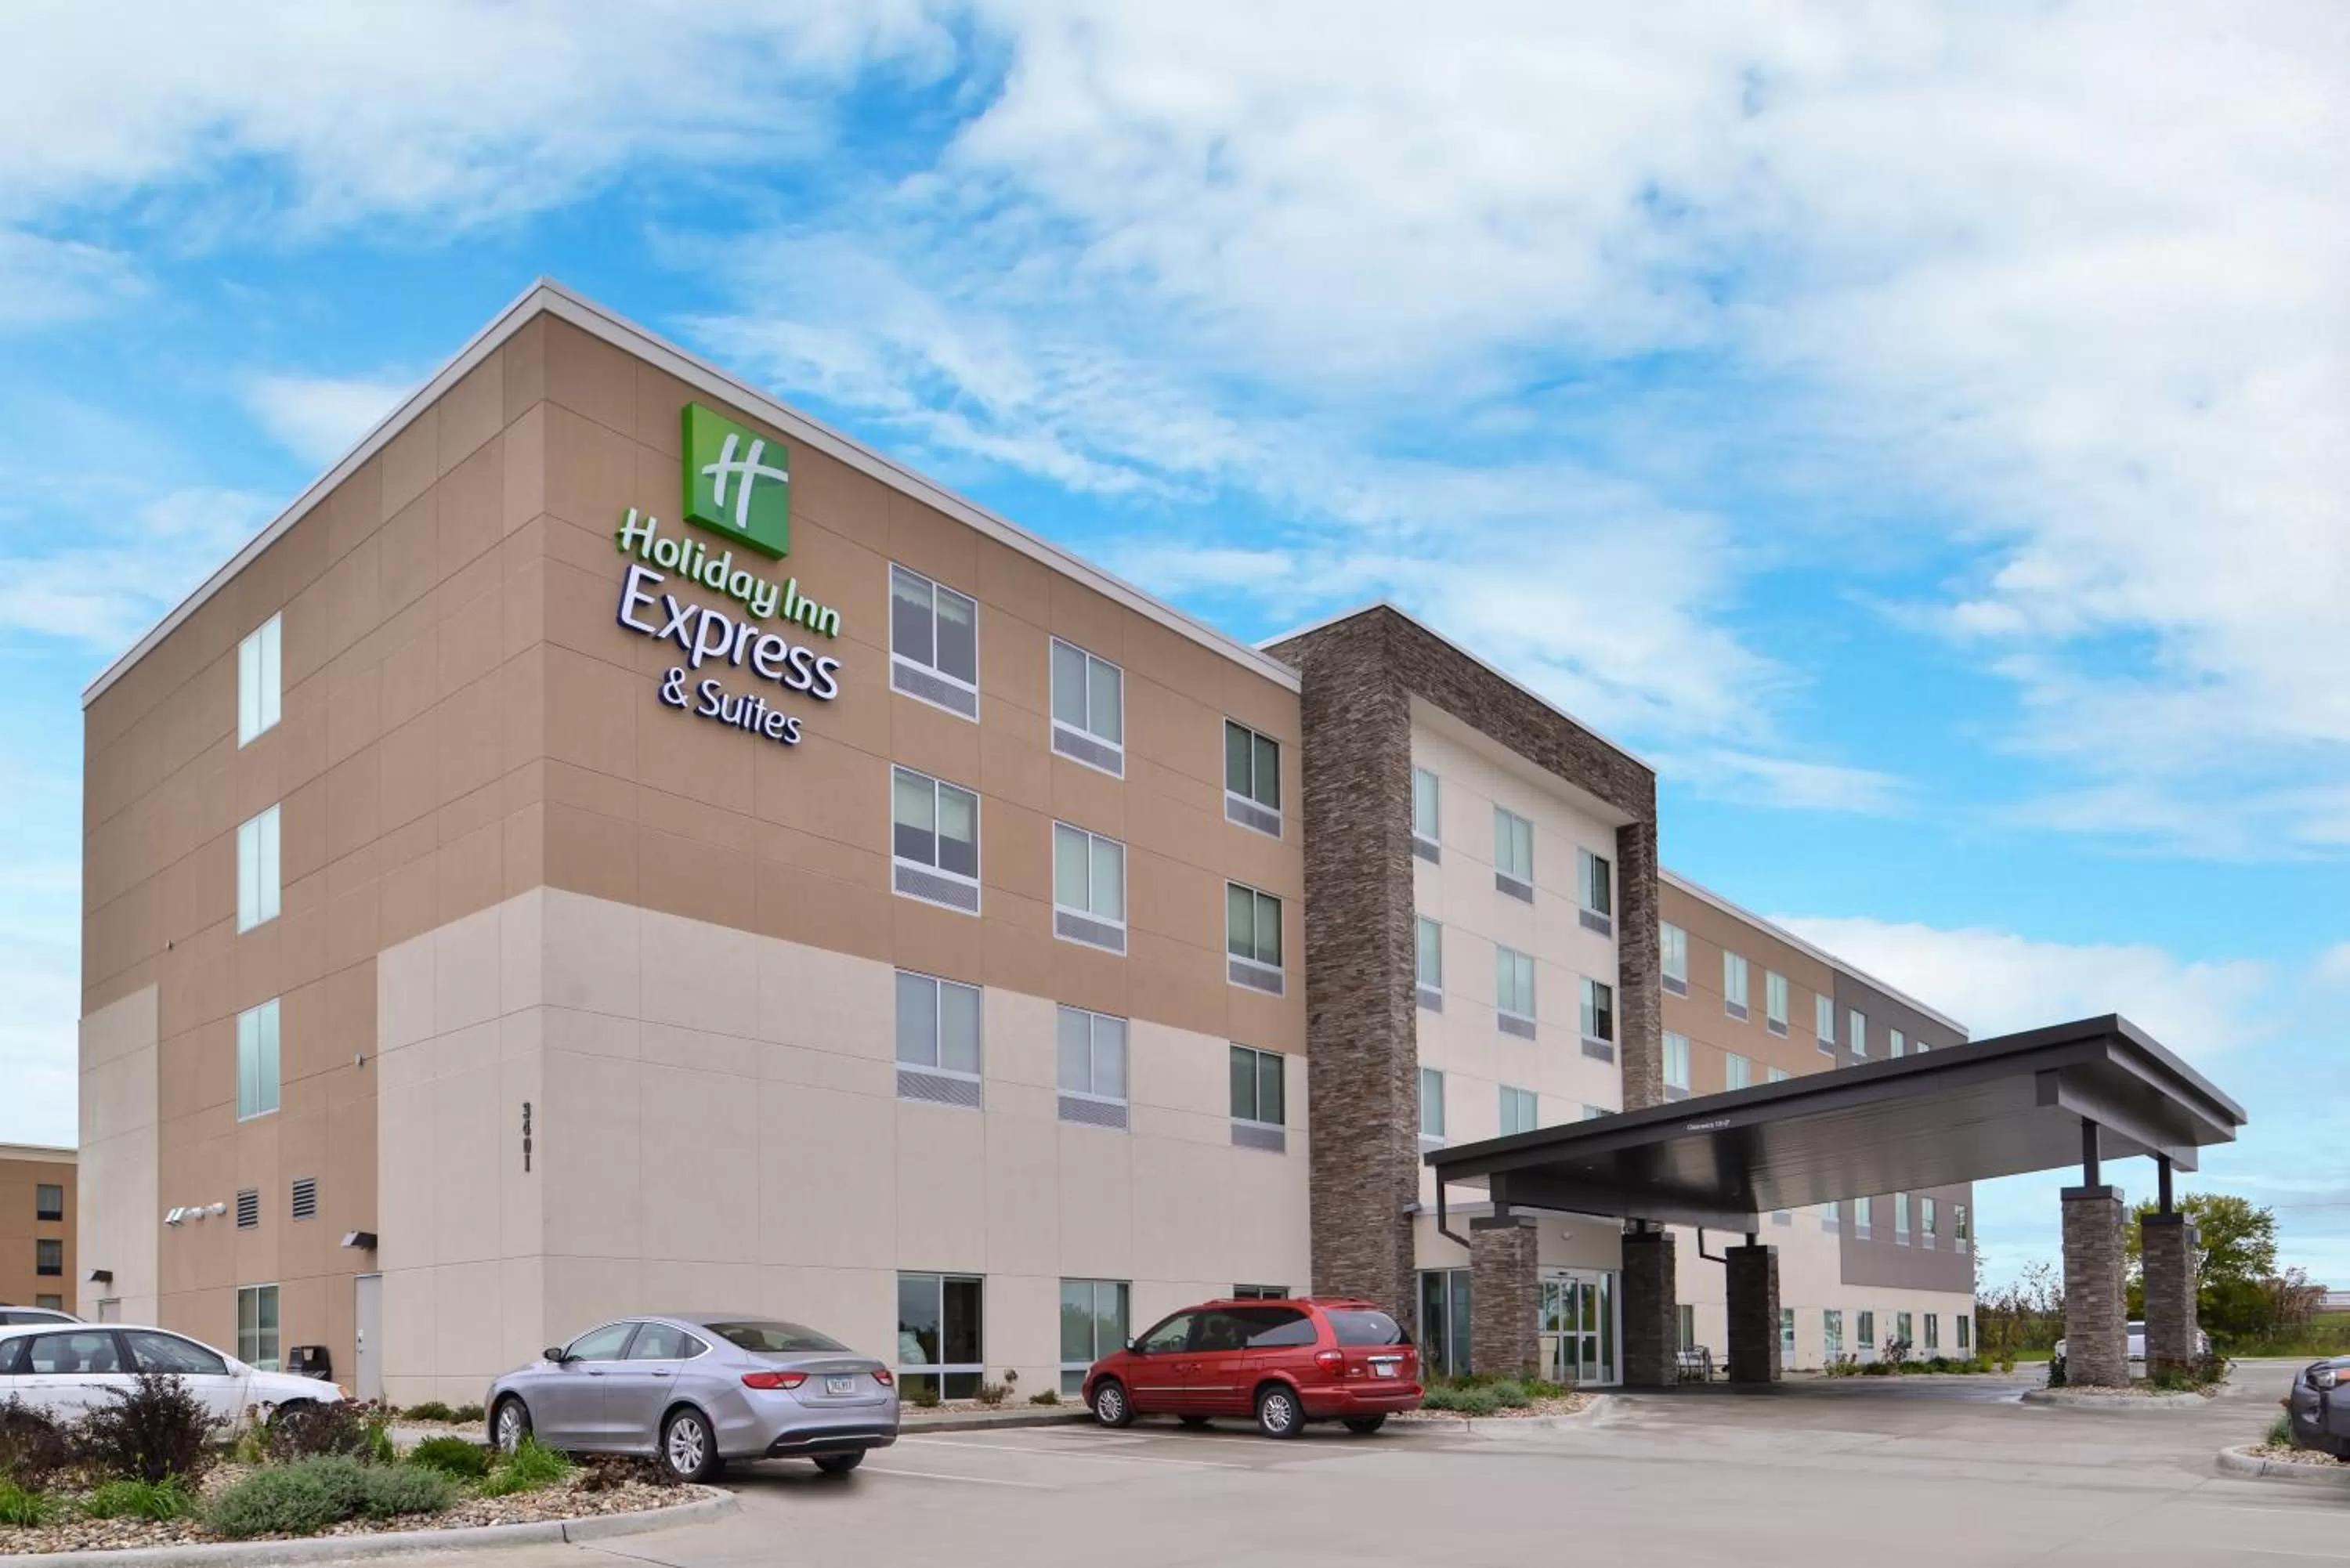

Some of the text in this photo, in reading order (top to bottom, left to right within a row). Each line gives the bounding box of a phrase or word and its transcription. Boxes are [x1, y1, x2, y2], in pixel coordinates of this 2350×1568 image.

[701, 432, 789, 529] H
[616, 508, 841, 638] Holiday Inn
[617, 564, 841, 701] Express
[660, 667, 802, 745] & Suites
